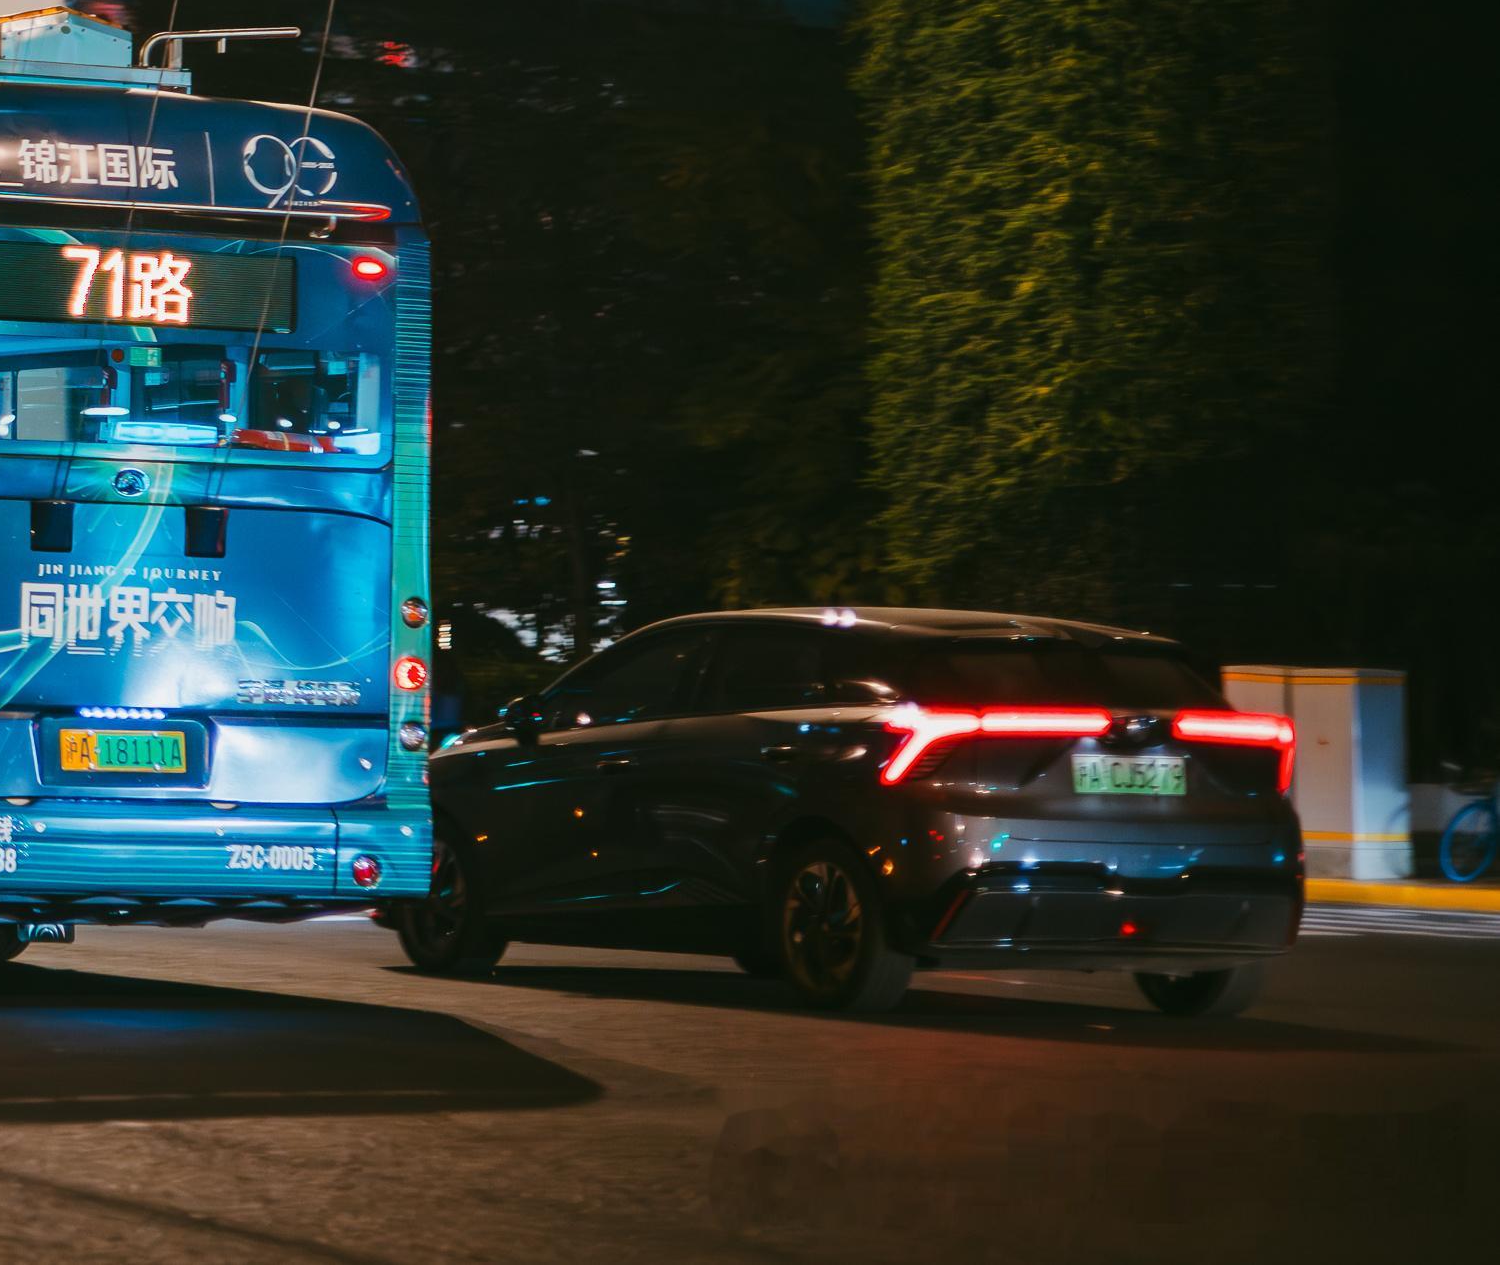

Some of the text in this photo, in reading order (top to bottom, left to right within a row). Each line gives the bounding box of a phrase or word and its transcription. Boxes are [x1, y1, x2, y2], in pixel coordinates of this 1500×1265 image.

[18, 138, 179, 190] 锦江国际
[62, 245, 194, 324] 71路
[38, 563, 224, 582] JIN JIANG JOURNEY
